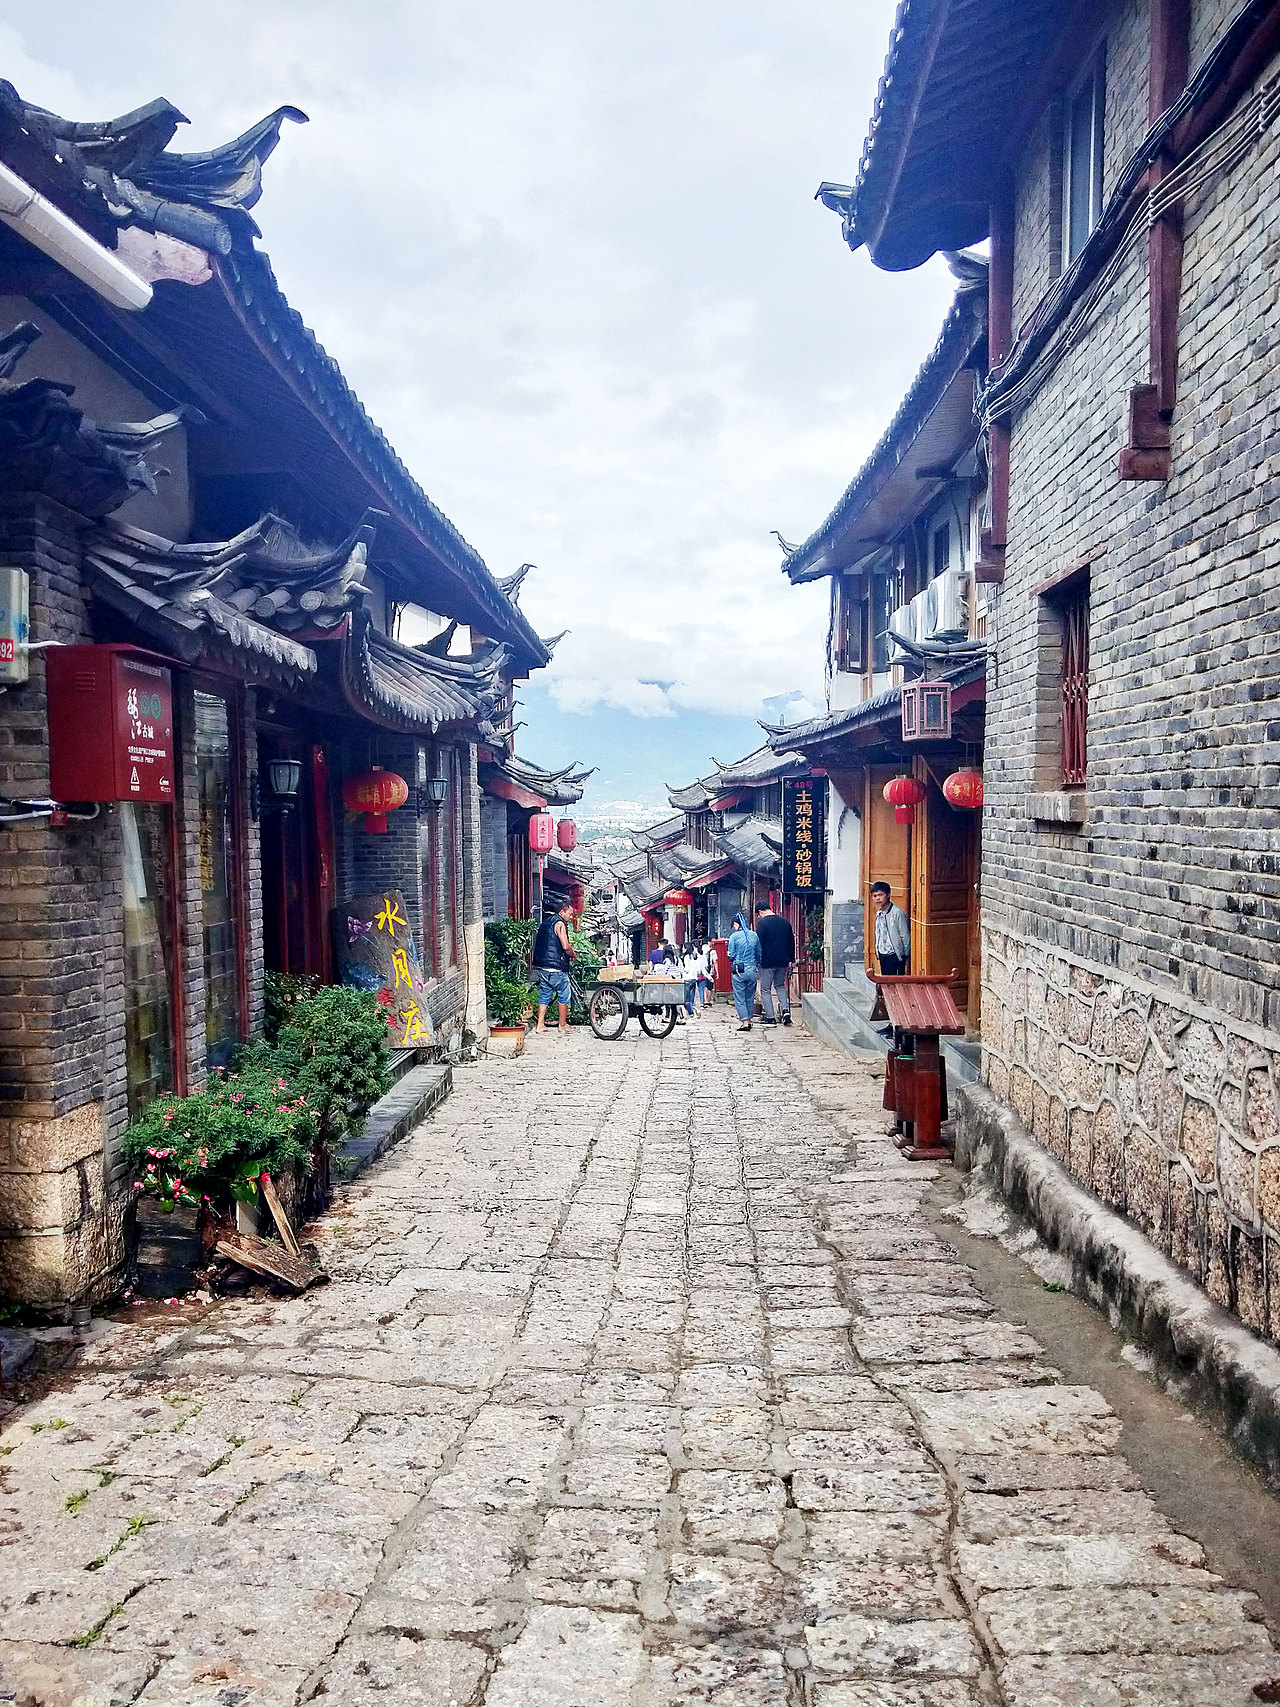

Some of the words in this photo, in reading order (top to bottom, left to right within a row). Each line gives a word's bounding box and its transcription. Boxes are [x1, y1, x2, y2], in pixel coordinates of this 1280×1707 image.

[0, 642, 12, 658] 92
[794, 780, 813, 790] 48号
[374, 898, 430, 1044] 水月庄
